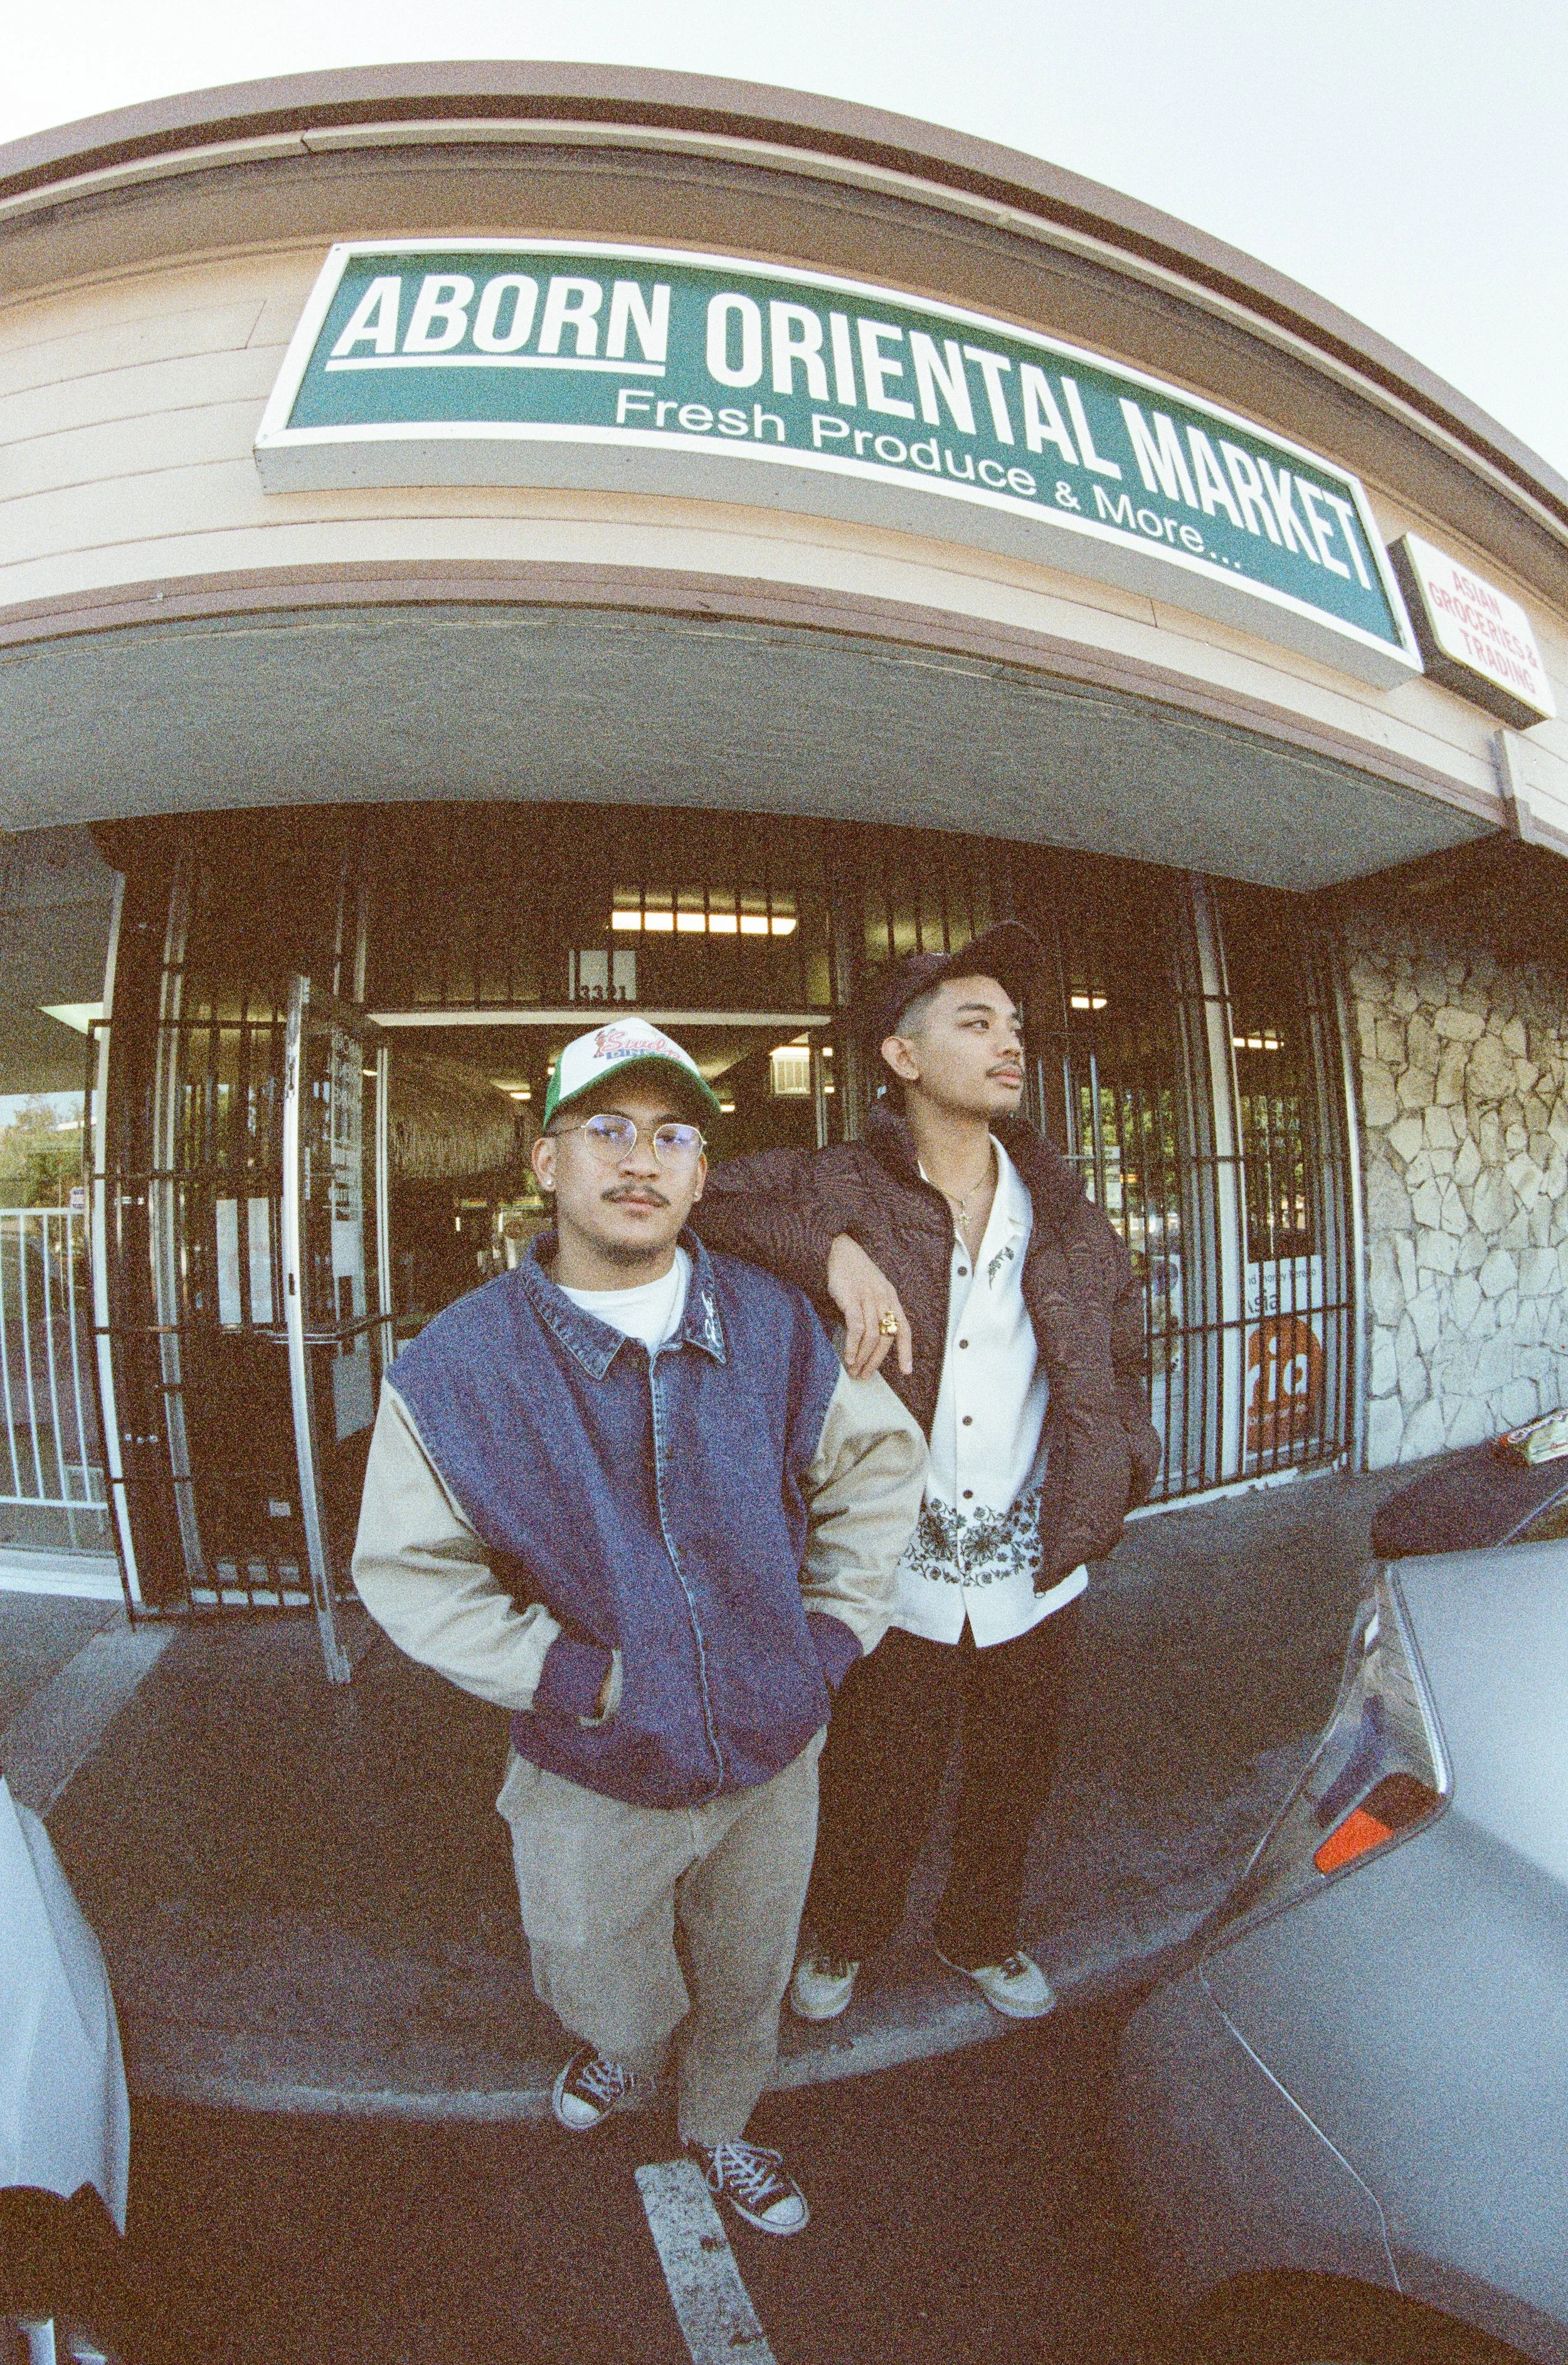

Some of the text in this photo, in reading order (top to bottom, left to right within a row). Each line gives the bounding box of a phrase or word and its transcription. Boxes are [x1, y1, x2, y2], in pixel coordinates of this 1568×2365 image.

[331, 274, 1372, 590] ABORN ORIENTAL MARKET
[617, 389, 785, 441] Fresh
[812, 414, 1036, 495] Produce
[1055, 481, 1080, 509] &
[1428, 581, 1525, 661] GROCERIES
[1453, 570, 1503, 620] ASIAN
[1459, 627, 1536, 694] TRADING
